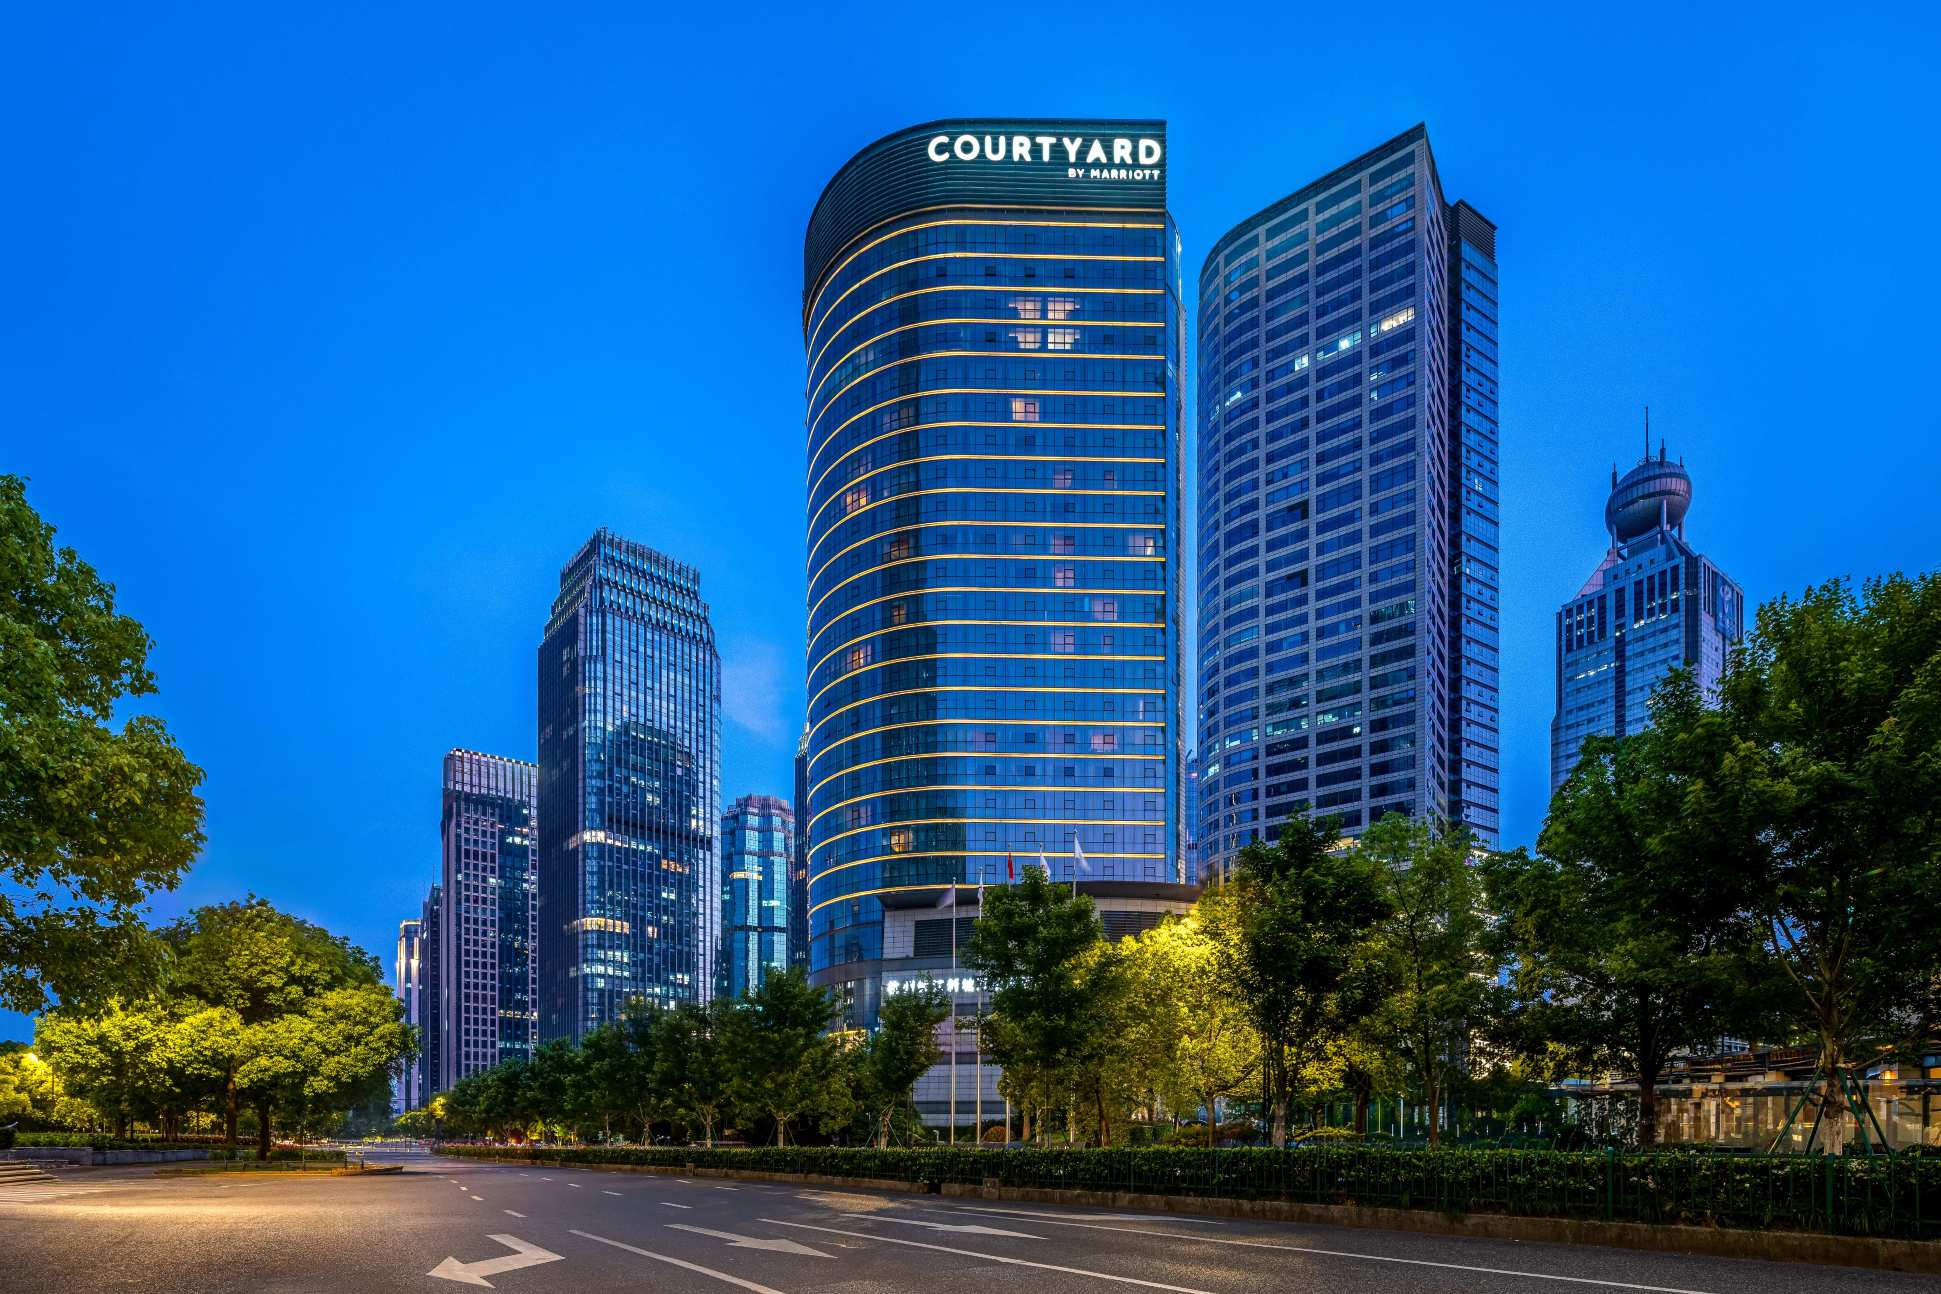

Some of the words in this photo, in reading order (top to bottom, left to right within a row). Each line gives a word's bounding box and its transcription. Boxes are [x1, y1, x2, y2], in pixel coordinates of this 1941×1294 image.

[927, 134, 1162, 165] COURTYARD
[1067, 167, 1085, 178] BY
[1090, 169, 1161, 181] MARRIOTT
